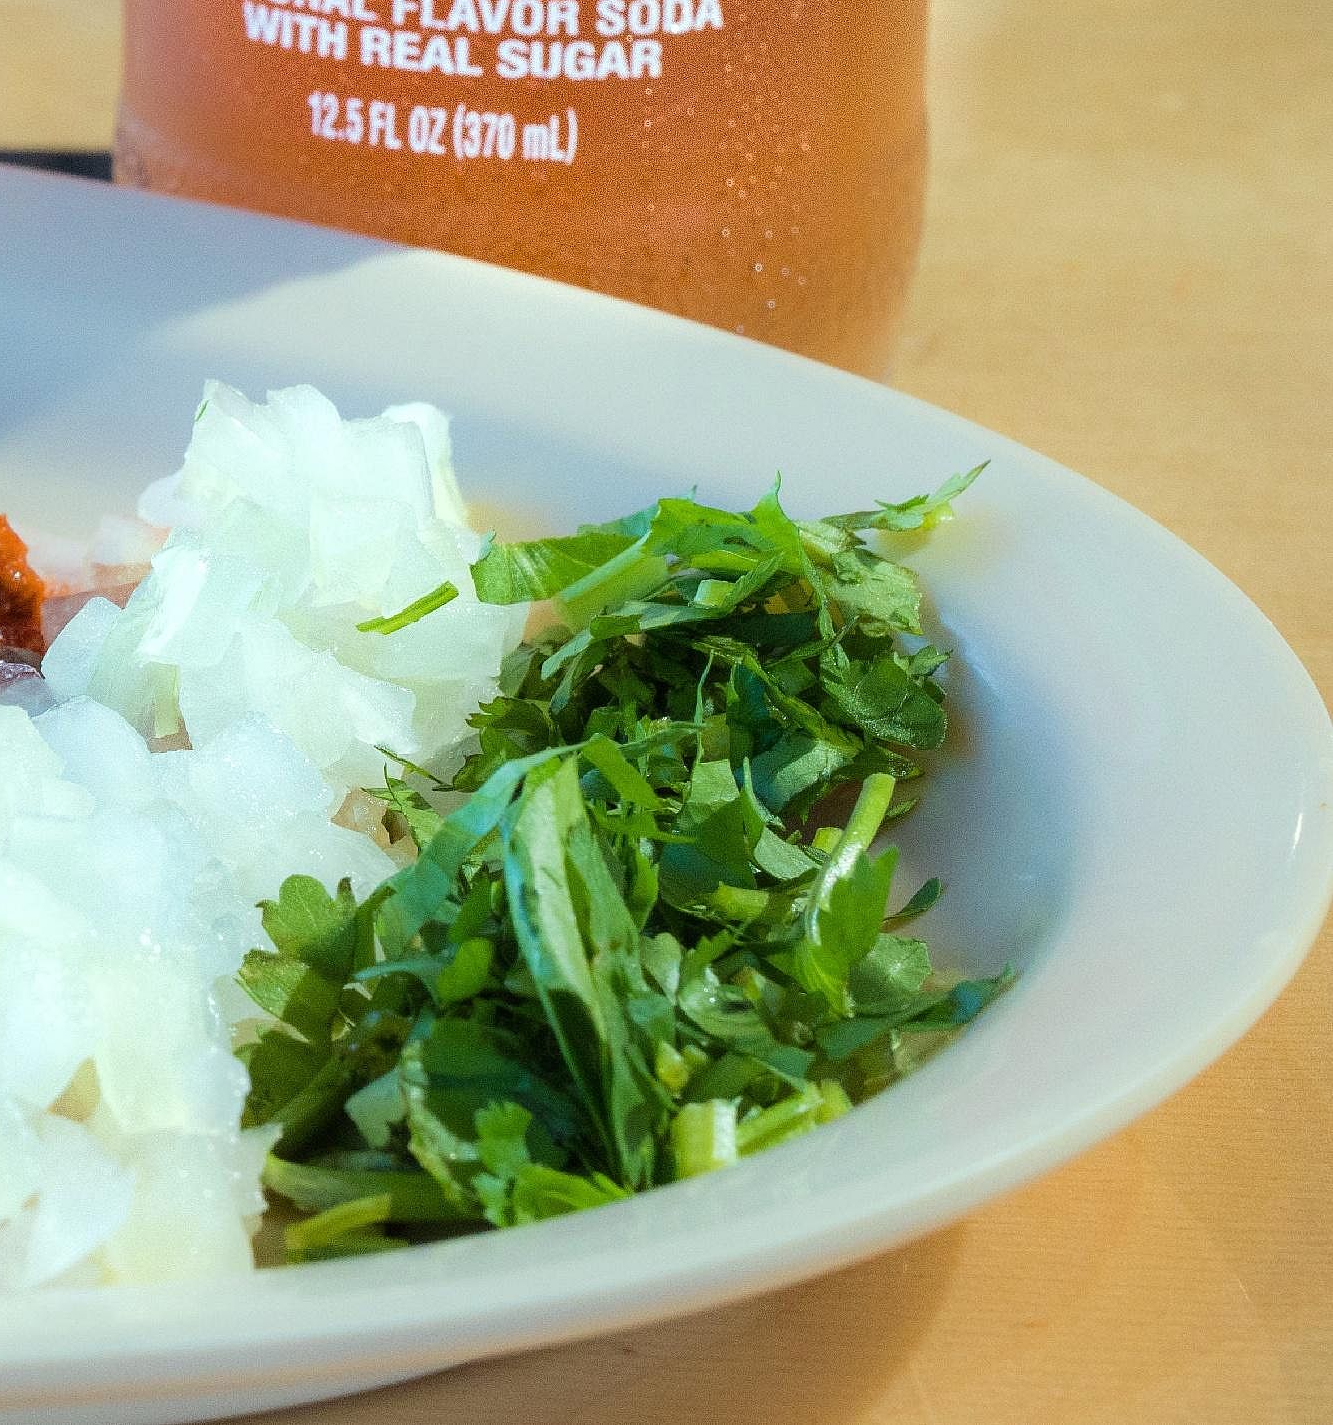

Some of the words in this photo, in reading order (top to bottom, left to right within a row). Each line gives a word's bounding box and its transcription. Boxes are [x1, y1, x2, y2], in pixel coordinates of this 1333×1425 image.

[241, 0, 348, 61] WITH
[359, 26, 484, 78] REAL
[496, 37, 663, 81] SUGAR
[308, 90, 363, 145] 12.5
[368, 98, 401, 151] FL
[408, 104, 447, 156] OZ
[451, 102, 515, 161] (370
[521, 106, 578, 165] mL)
